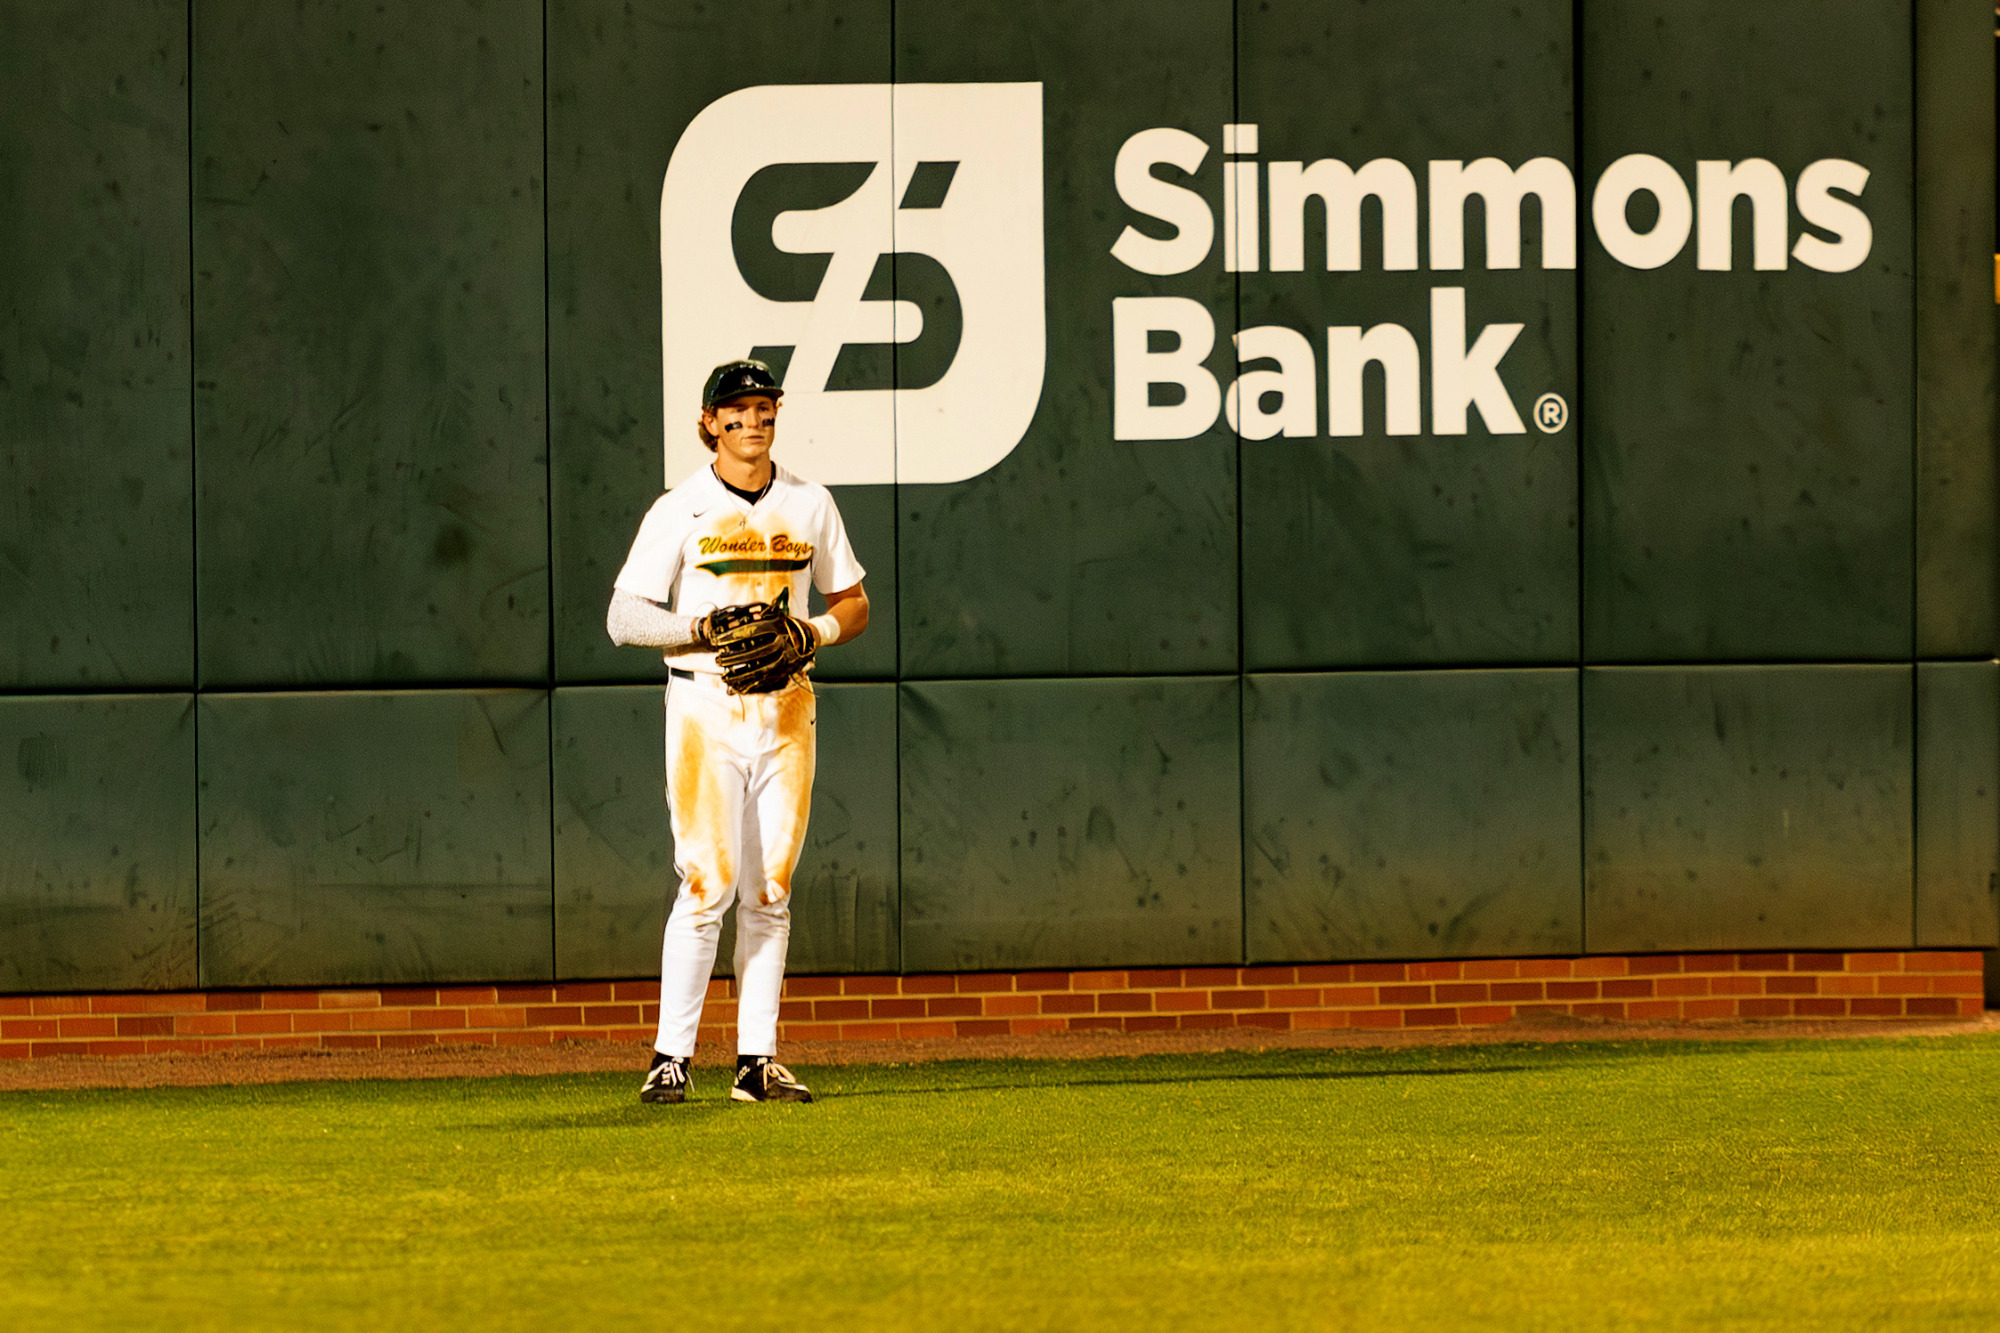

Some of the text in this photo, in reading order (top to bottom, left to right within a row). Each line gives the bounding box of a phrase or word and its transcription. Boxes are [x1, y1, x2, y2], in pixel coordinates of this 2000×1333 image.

[1110, 123, 1873, 276] Simmons
[698, 534, 810, 557] Wonder Boys
